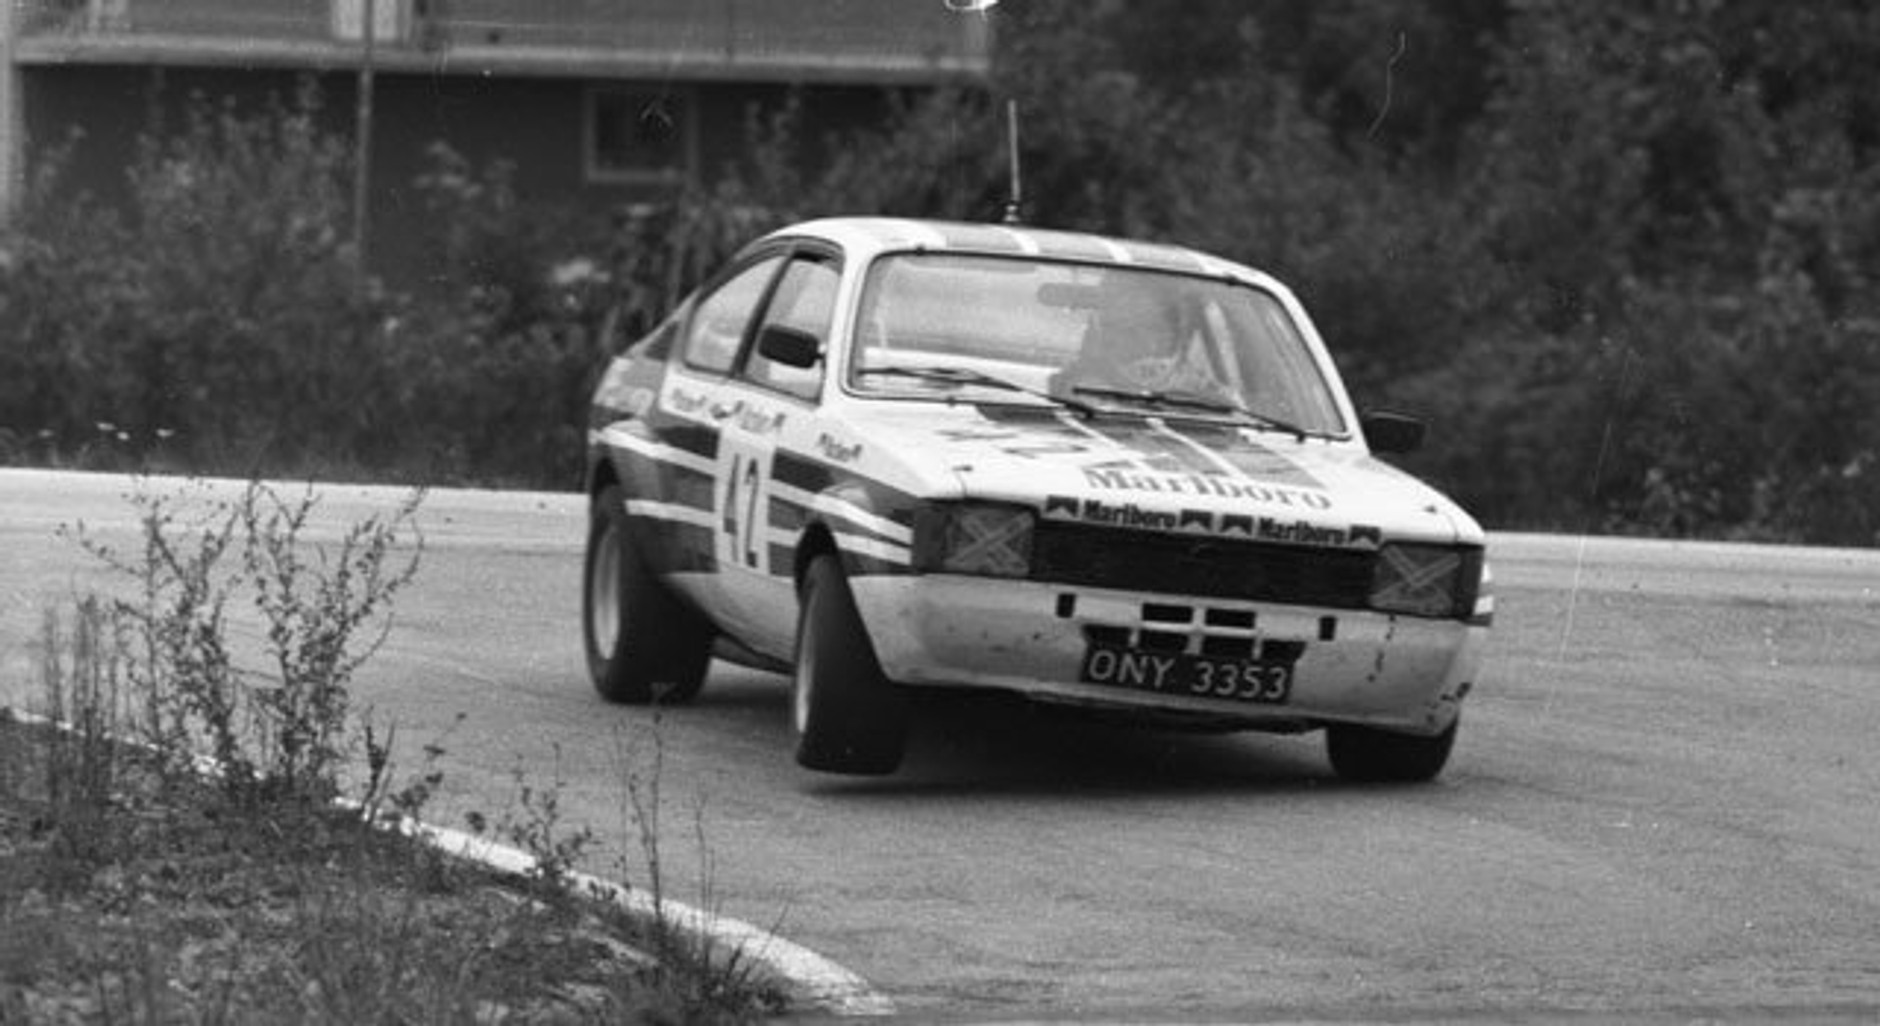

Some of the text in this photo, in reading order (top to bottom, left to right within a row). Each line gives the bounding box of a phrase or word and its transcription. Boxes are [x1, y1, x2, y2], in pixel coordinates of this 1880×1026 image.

[1082, 468, 1332, 510] Marlboro
[722, 452, 760, 569] 42
[1084, 499, 1177, 530] Marlboro
[1259, 517, 1346, 545] Marlboro
[1088, 650, 1288, 699] ONY 3353
